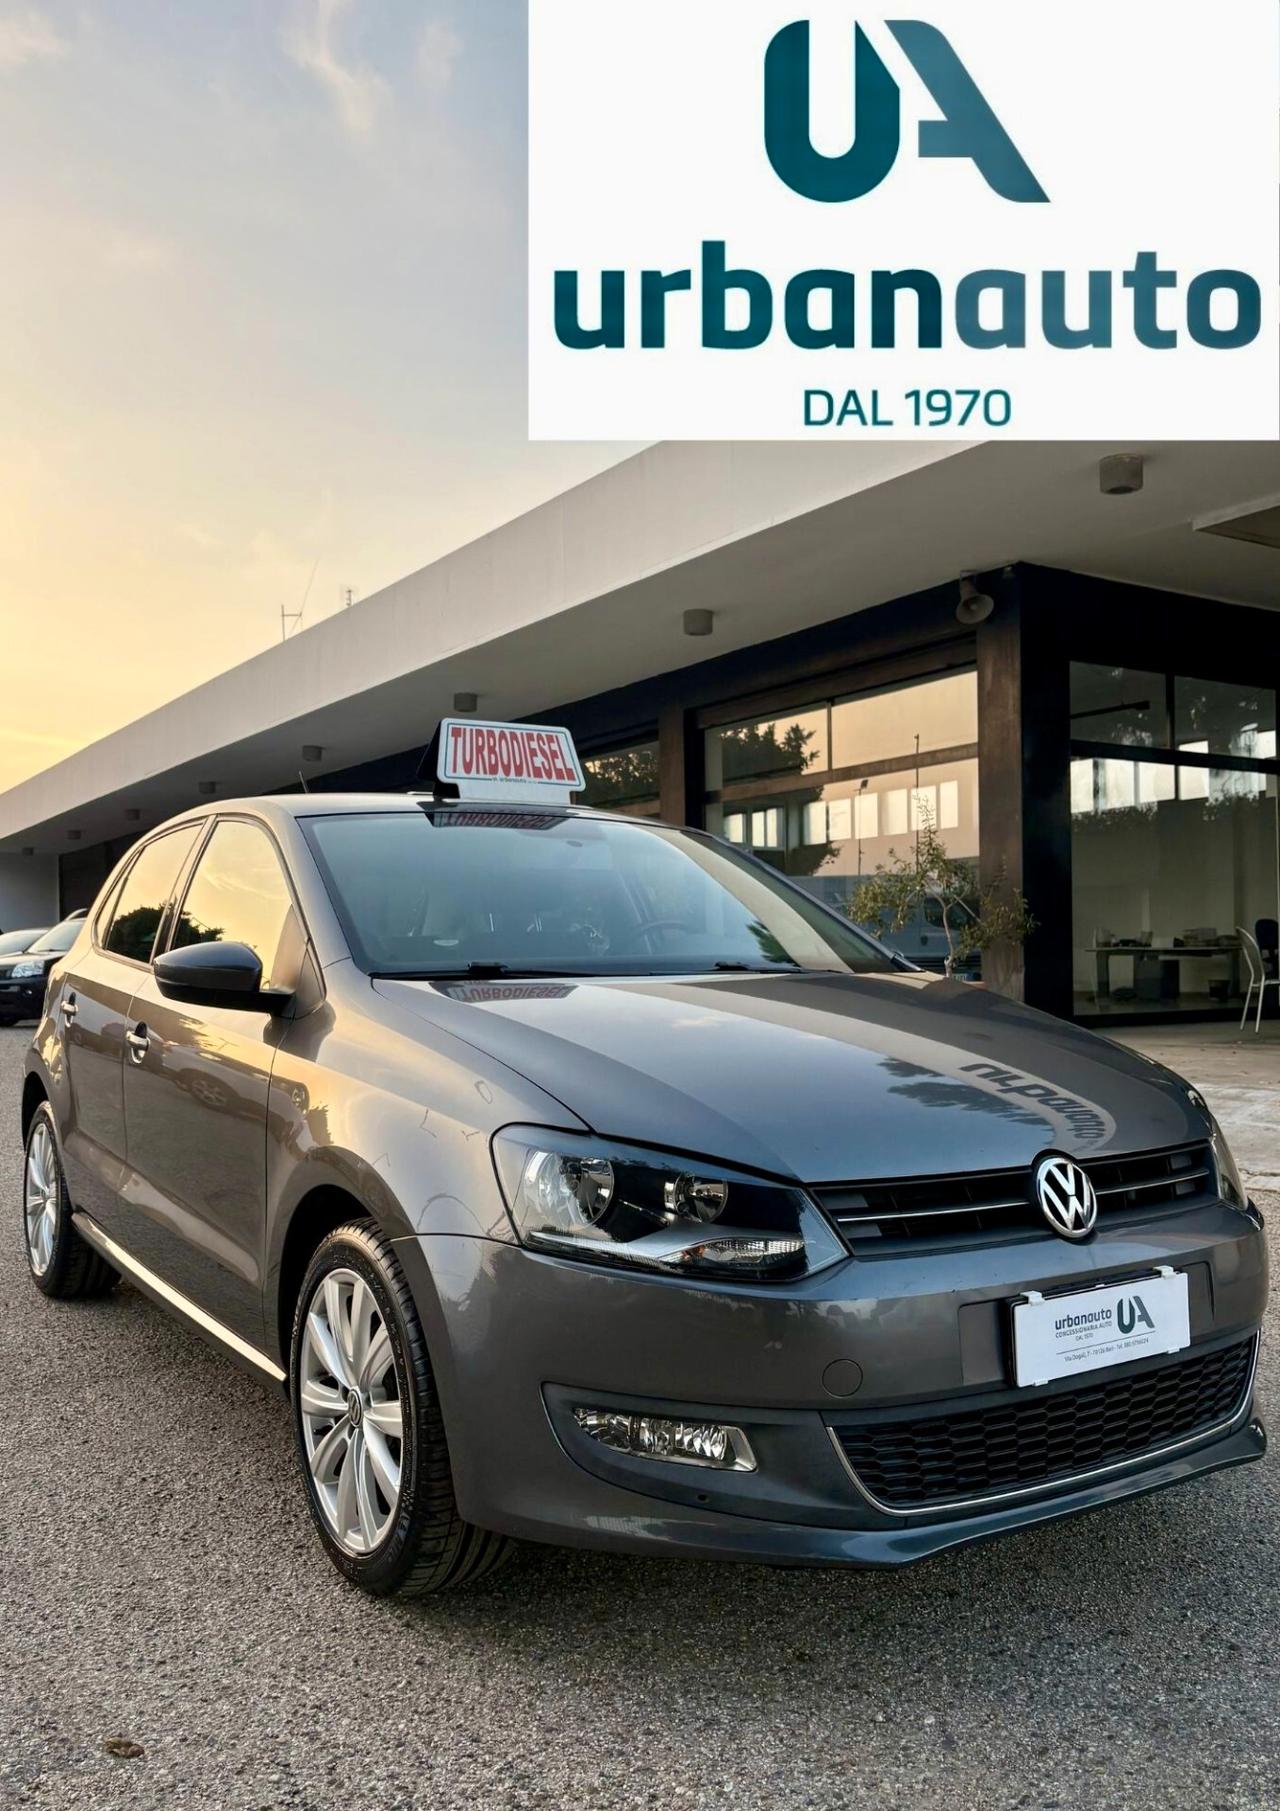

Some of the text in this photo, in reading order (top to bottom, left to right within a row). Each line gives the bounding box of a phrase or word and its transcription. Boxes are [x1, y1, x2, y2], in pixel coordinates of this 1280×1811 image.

[451, 727, 576, 782] TURBODIESEL
[1037, 1158, 1097, 1238] VW
[1055, 1308, 1112, 1330] urbanauto
[1117, 1295, 1155, 1334] UA
